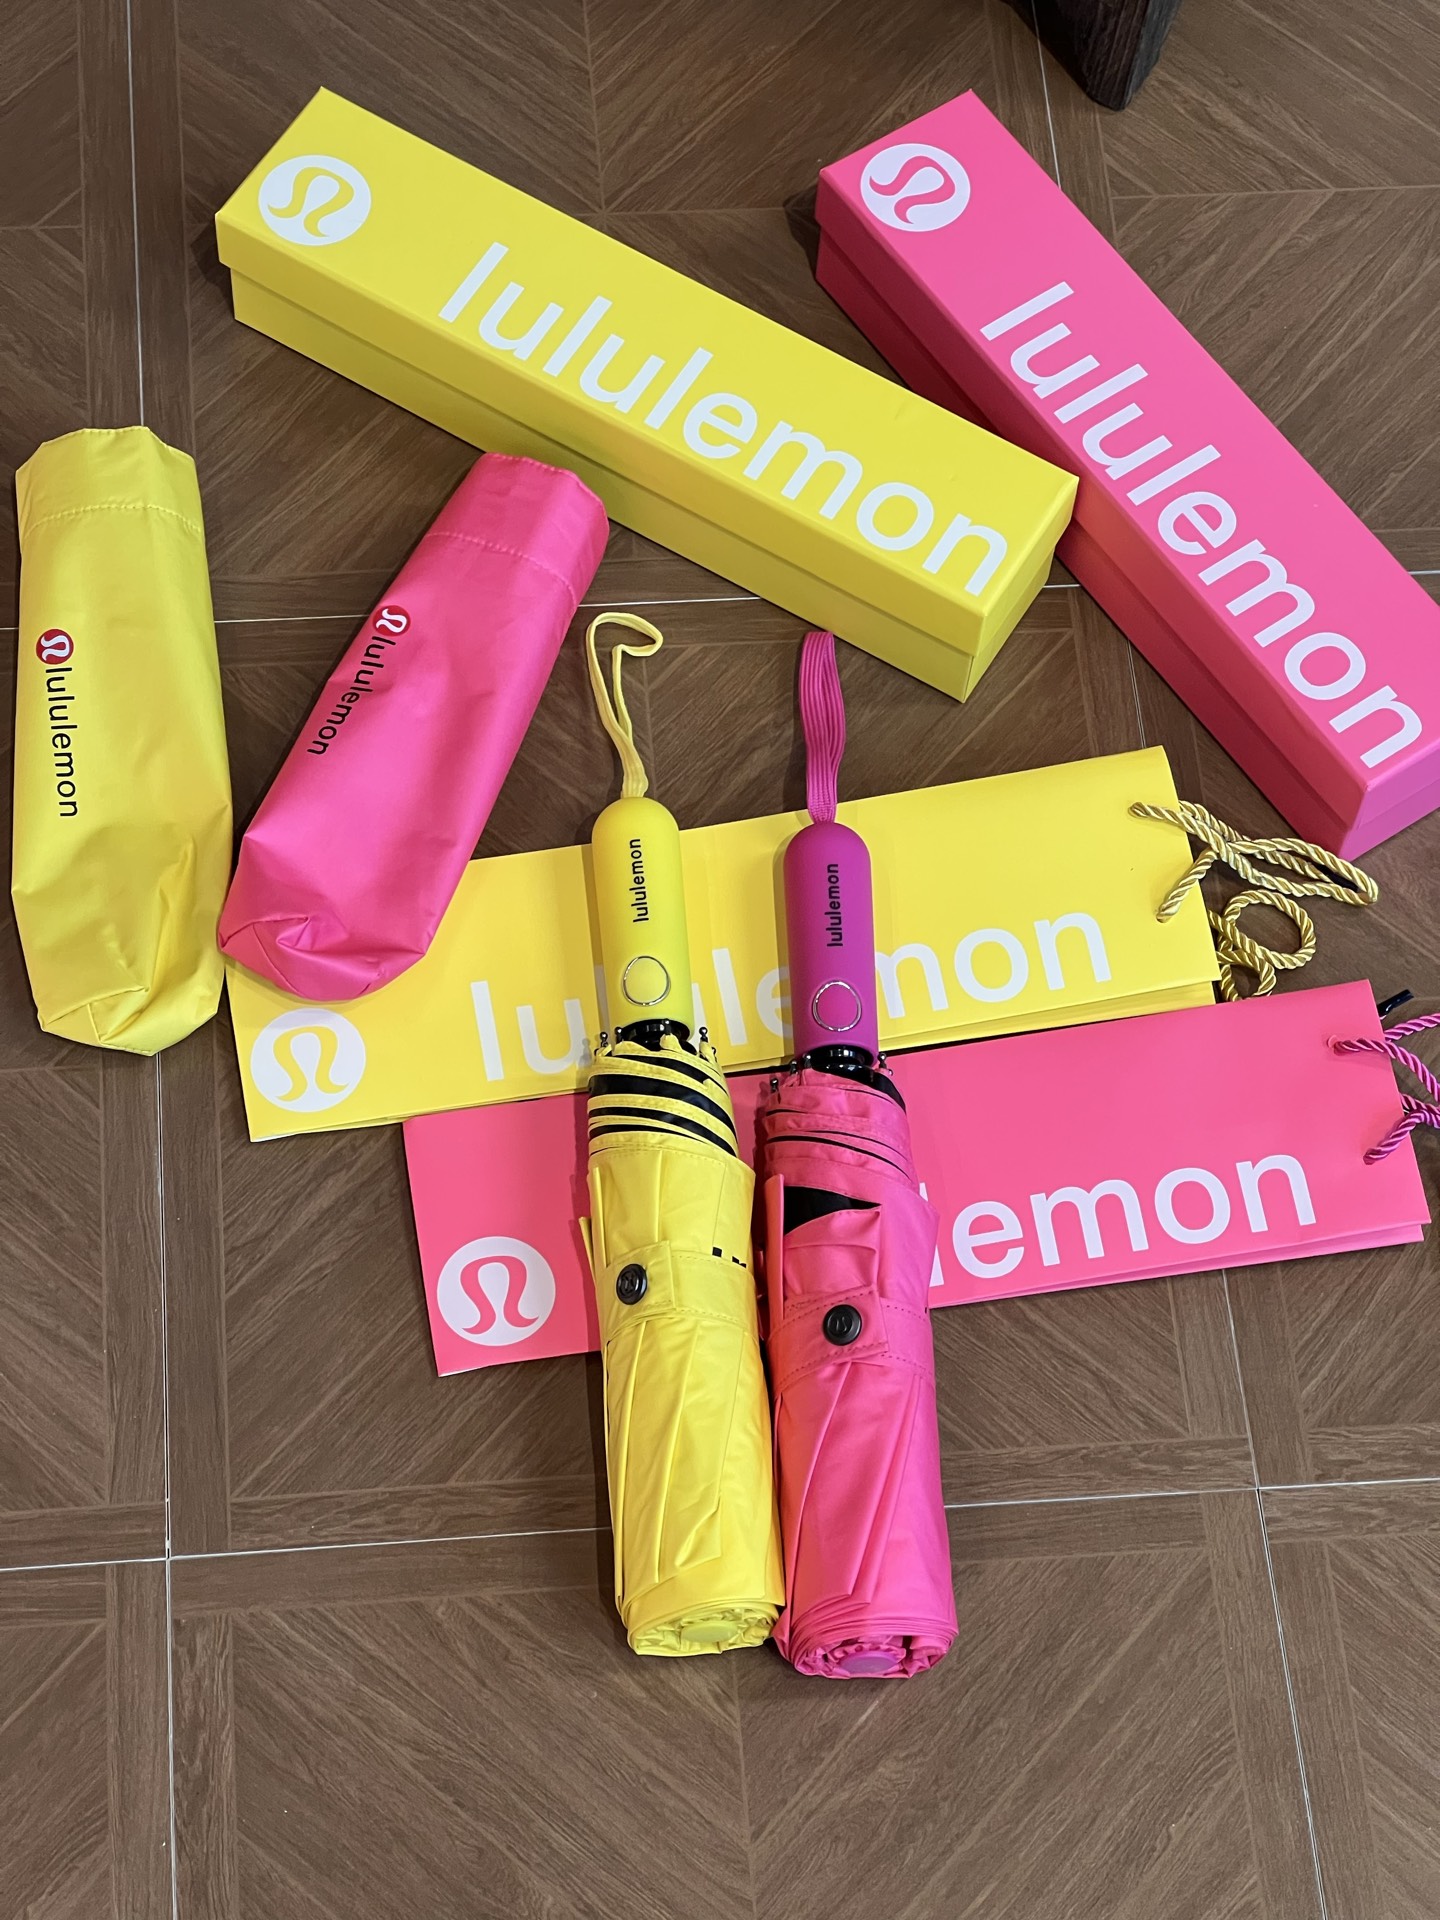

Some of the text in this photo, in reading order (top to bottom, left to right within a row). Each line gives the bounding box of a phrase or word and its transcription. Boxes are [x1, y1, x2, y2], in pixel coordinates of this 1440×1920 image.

[438, 241, 1009, 598] lululemon
[979, 281, 1425, 770] lululemon
[45, 666, 79, 818] lululemon
[307, 636, 397, 755] lululemon
[628, 838, 651, 924] lululemon
[824, 863, 844, 948] lululemon
[470, 912, 1112, 1082] lulemon
